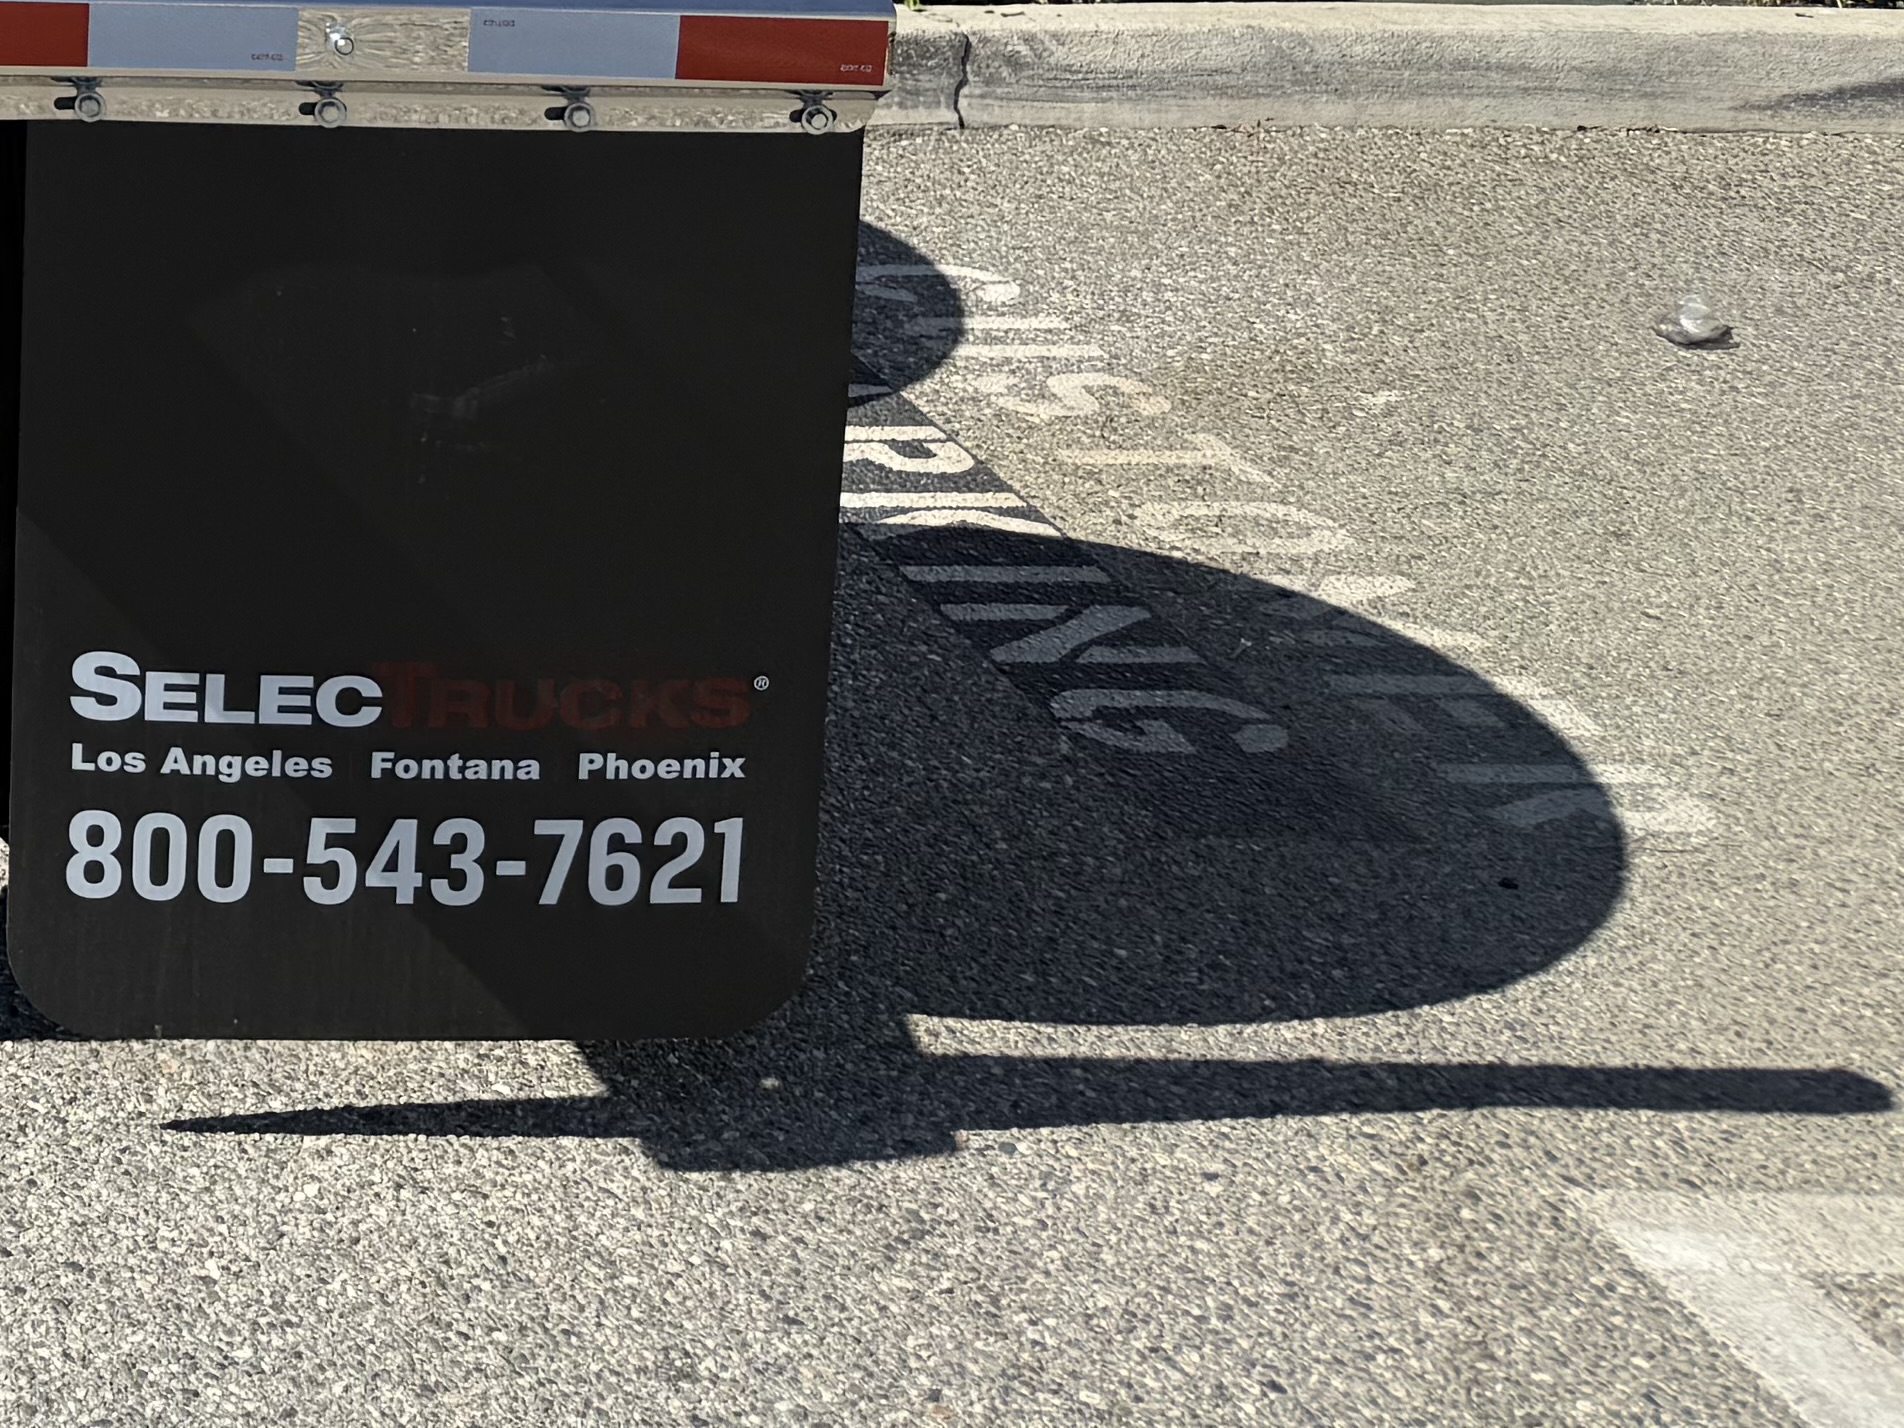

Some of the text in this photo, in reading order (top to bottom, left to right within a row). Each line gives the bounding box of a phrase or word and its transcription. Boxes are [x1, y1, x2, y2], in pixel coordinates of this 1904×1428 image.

[71, 742, 746, 783] Los Angeles Fontana Phoenix
[65, 809, 744, 907] 800-543-7621
